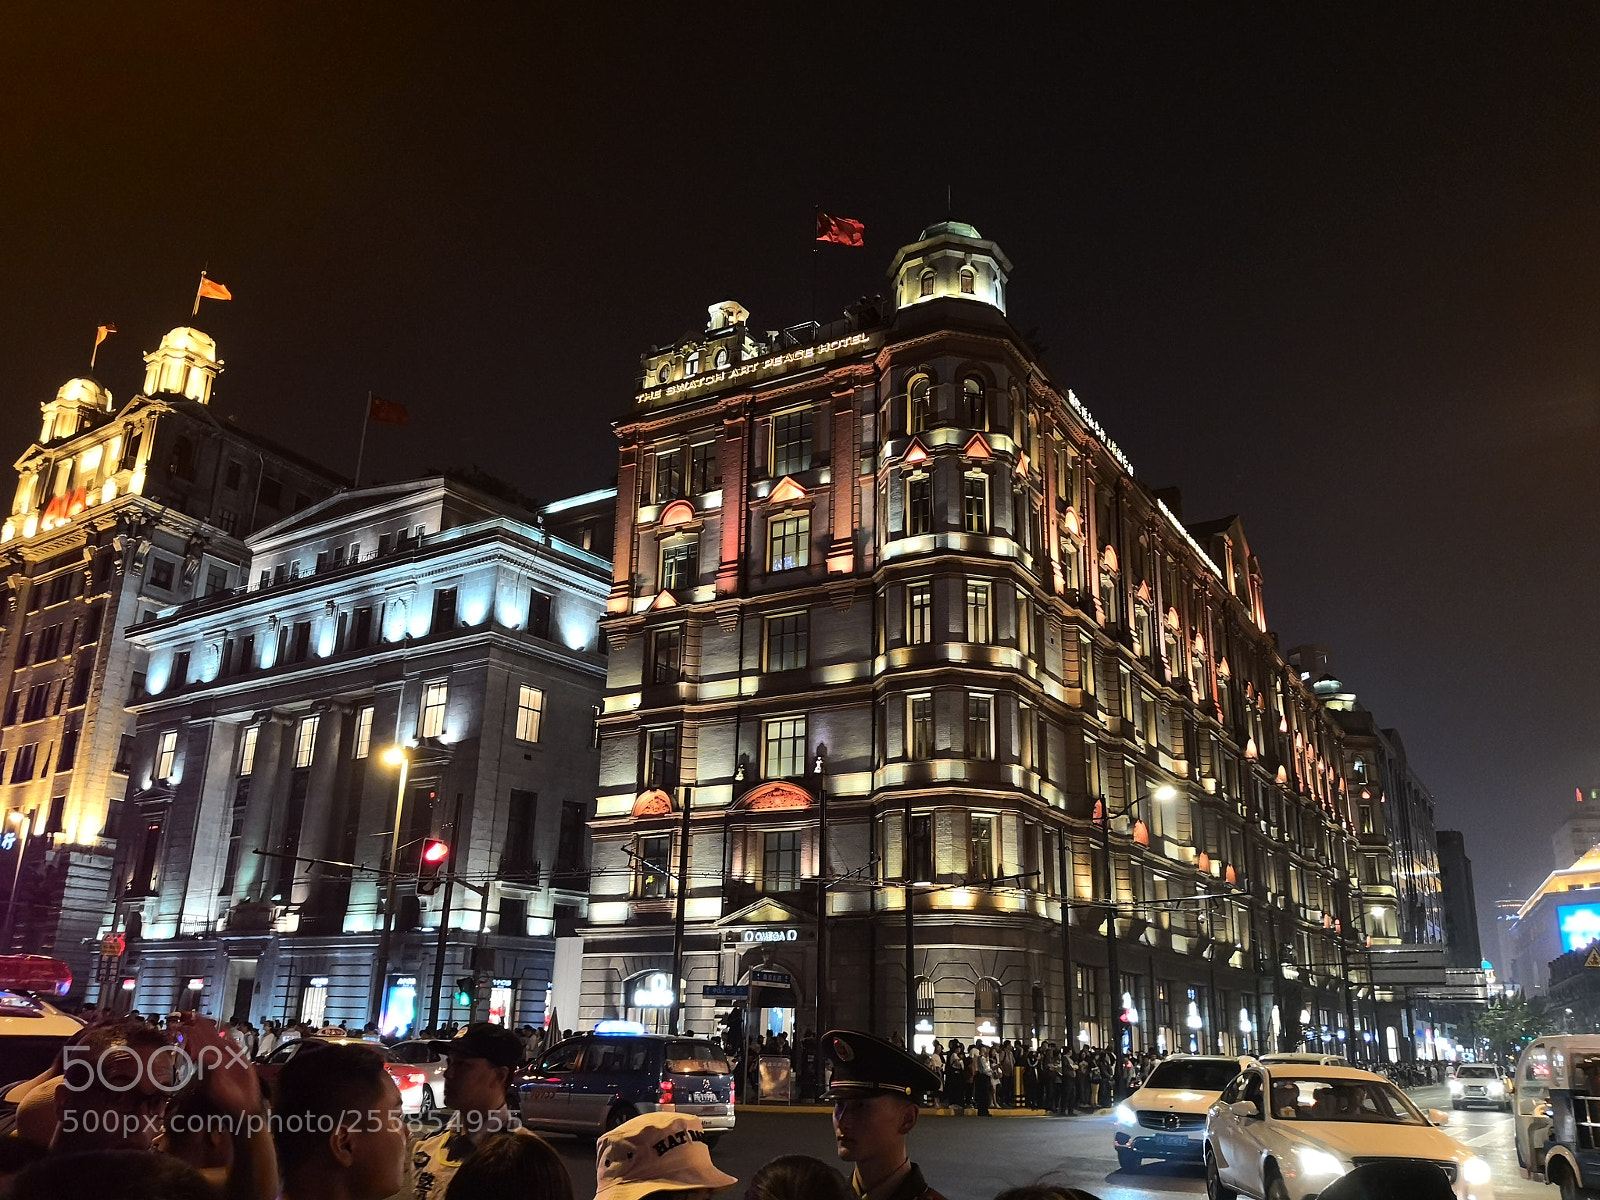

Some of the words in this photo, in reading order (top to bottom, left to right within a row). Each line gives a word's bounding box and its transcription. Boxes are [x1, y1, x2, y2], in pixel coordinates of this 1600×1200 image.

[635, 389, 662, 404] THE
[665, 371, 725, 395] SWATCH
[728, 361, 760, 380] ART
[762, 347, 814, 370] PEACE
[818, 332, 870, 355] HOTEL
[755, 931, 785, 942] OMEGA
[653, 1131, 686, 1156] HAT
